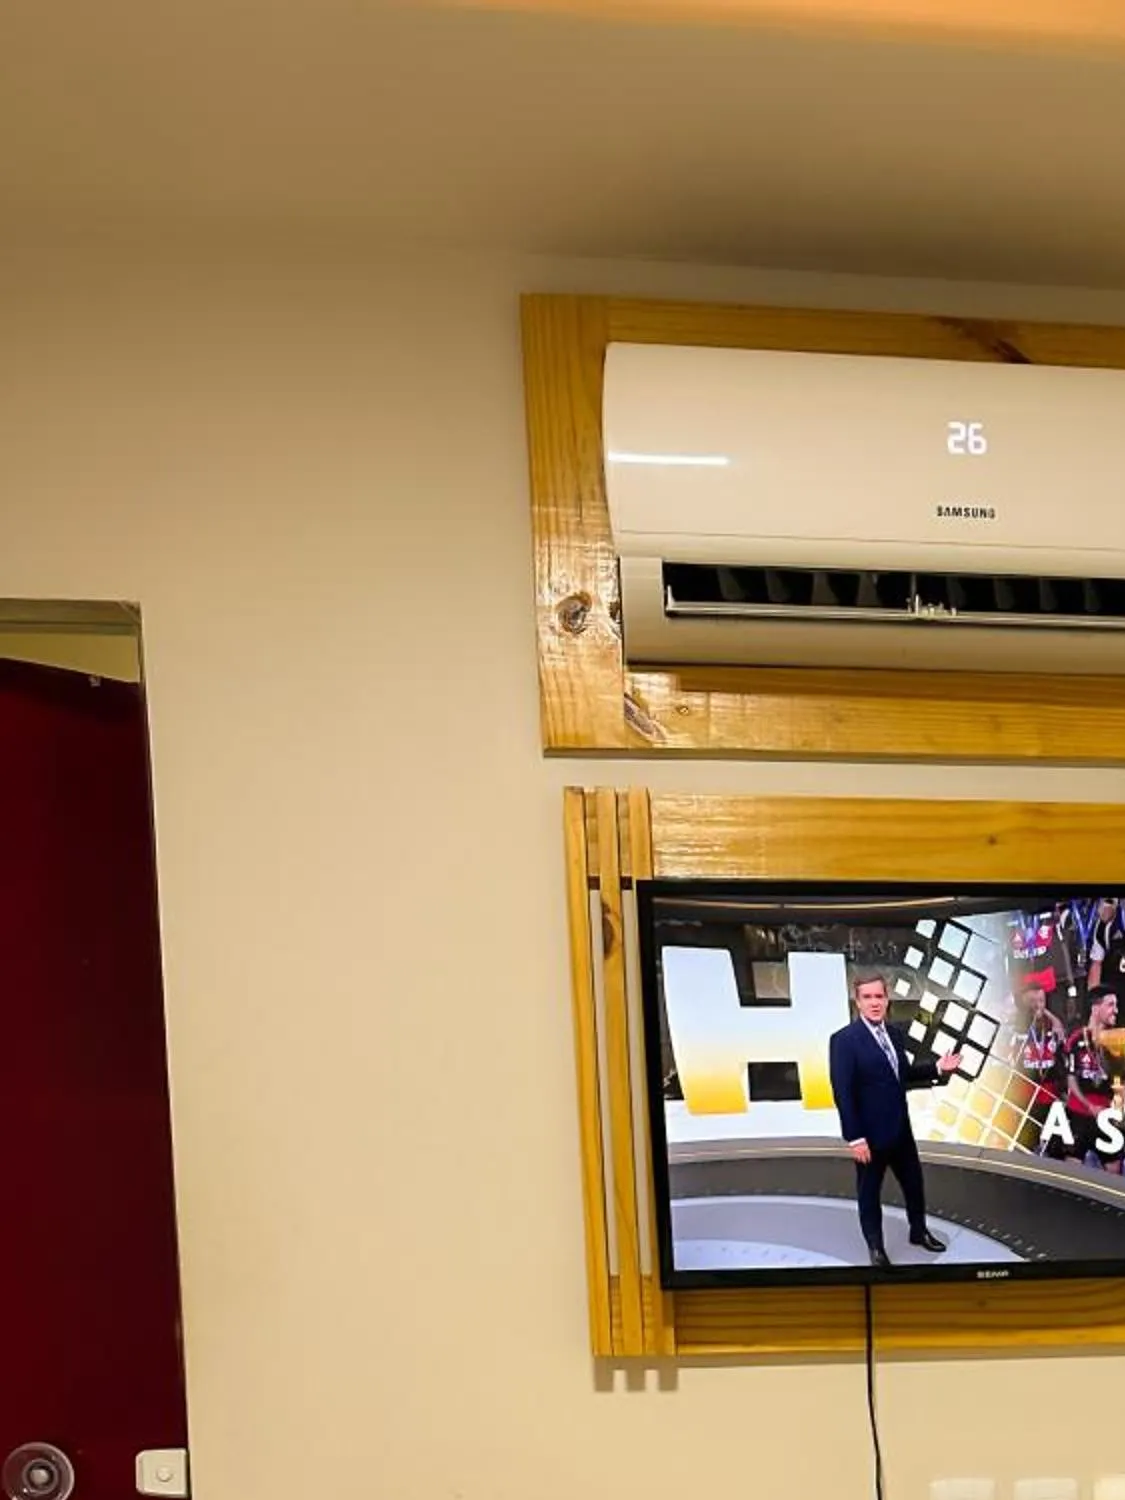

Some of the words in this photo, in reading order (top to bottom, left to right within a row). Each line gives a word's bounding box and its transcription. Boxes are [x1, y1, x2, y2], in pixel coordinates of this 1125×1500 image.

[947, 421, 987, 455] 26
[936, 505, 996, 519] SAMSUNG
[662, 946, 850, 1115] H
[1040, 1100, 1075, 1145] A
